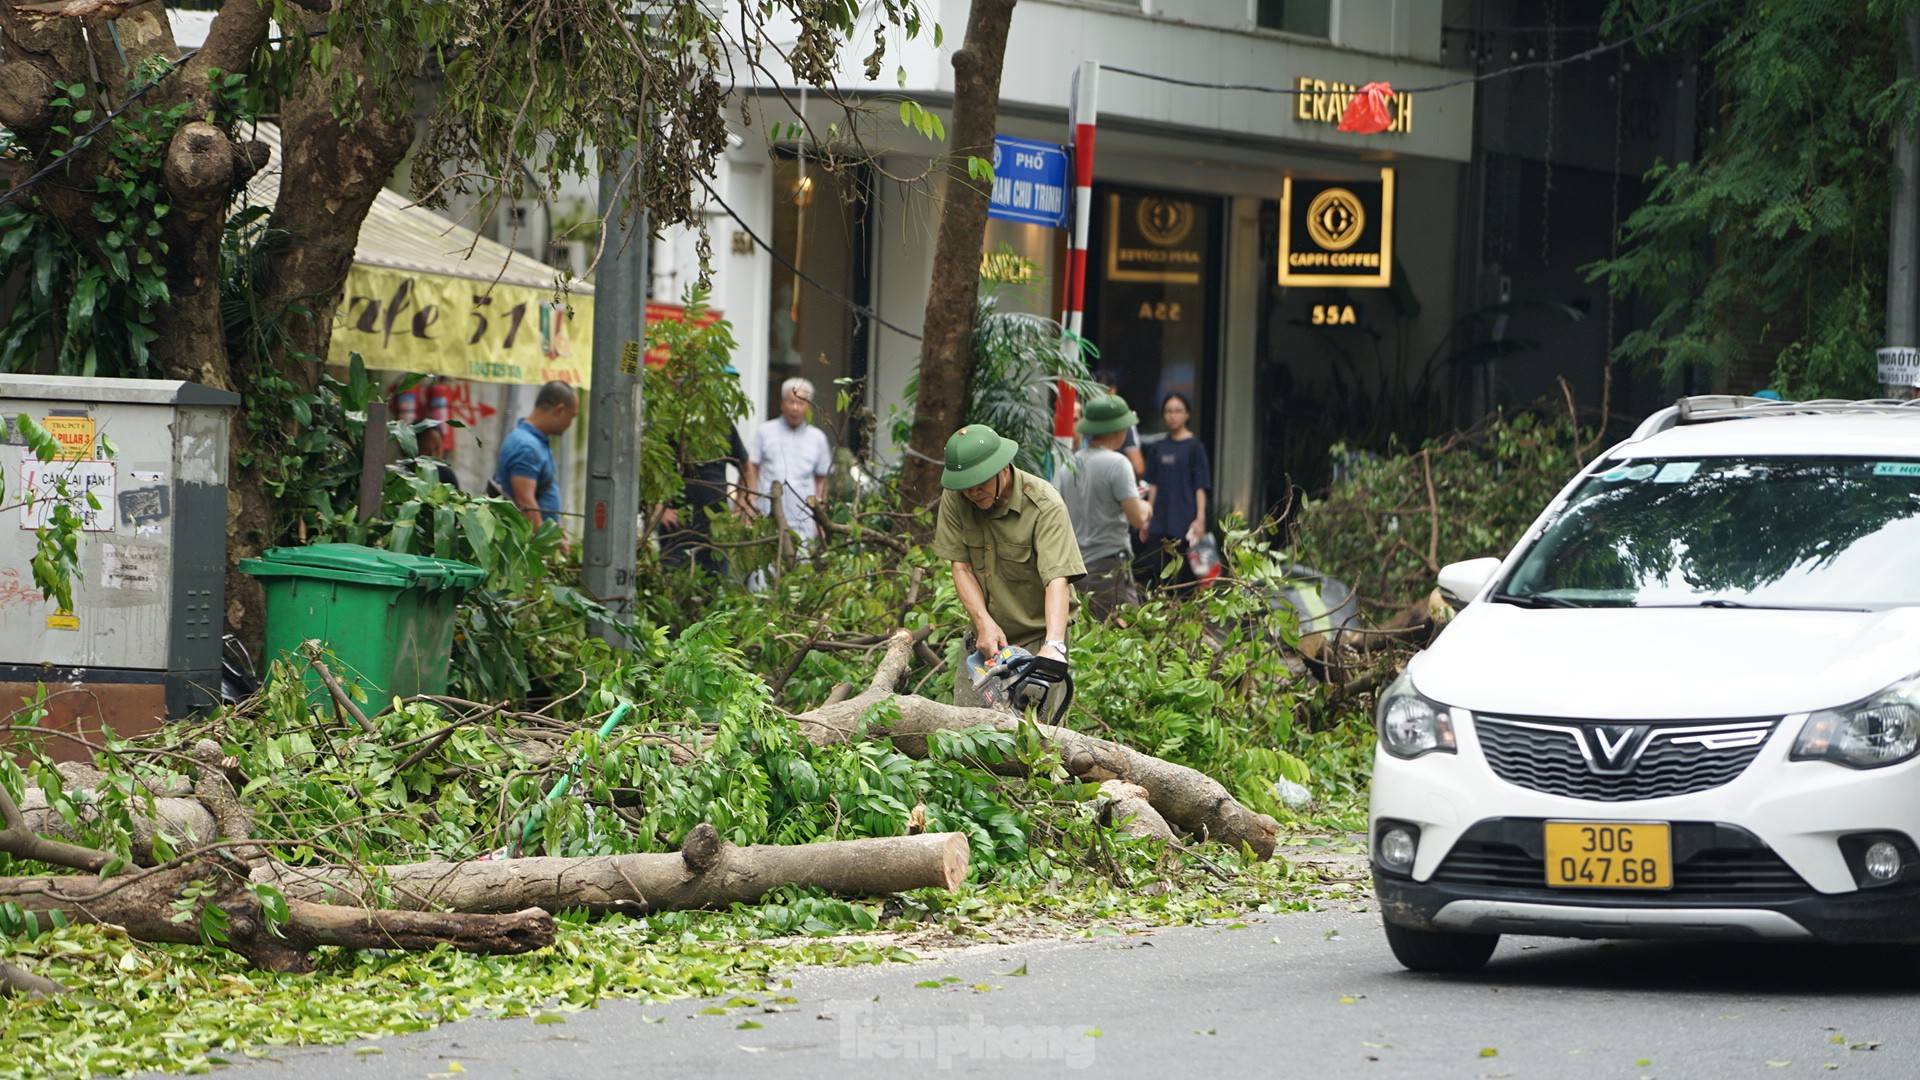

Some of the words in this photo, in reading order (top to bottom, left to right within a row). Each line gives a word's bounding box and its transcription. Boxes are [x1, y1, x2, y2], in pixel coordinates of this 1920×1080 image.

[1016, 151, 1045, 170] PHỐ
[1013, 180, 1033, 209] CHU
[1034, 185, 1063, 214] TRINH
[1290, 252, 1328, 268] CAPPI
[1330, 252, 1380, 268] COFFEE
[341, 277, 440, 350] afe
[1311, 305, 1357, 325] 55A
[57, 433, 83, 445] PILLAR
[84, 433, 90, 445] 3
[1581, 827, 1633, 853] 30G
[1560, 857, 1657, 884] 047.68
